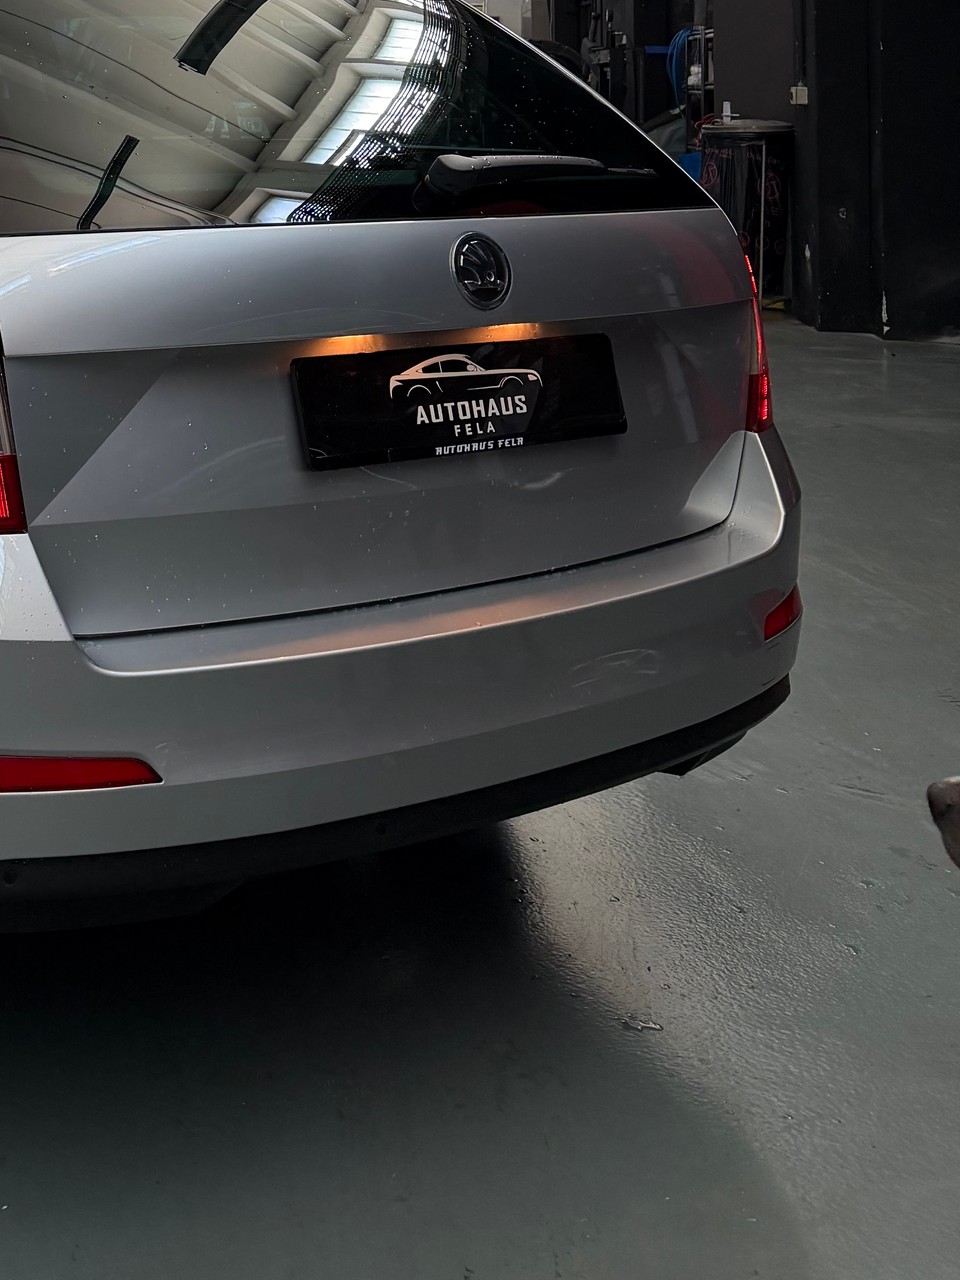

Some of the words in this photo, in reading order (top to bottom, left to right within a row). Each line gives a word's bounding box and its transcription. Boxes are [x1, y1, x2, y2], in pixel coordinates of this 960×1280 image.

[416, 394, 528, 425] AUTOHAUS
[454, 421, 496, 437] FELA
[435, 440, 494, 456] AUTOHAUS
[497, 436, 524, 448] FELA
